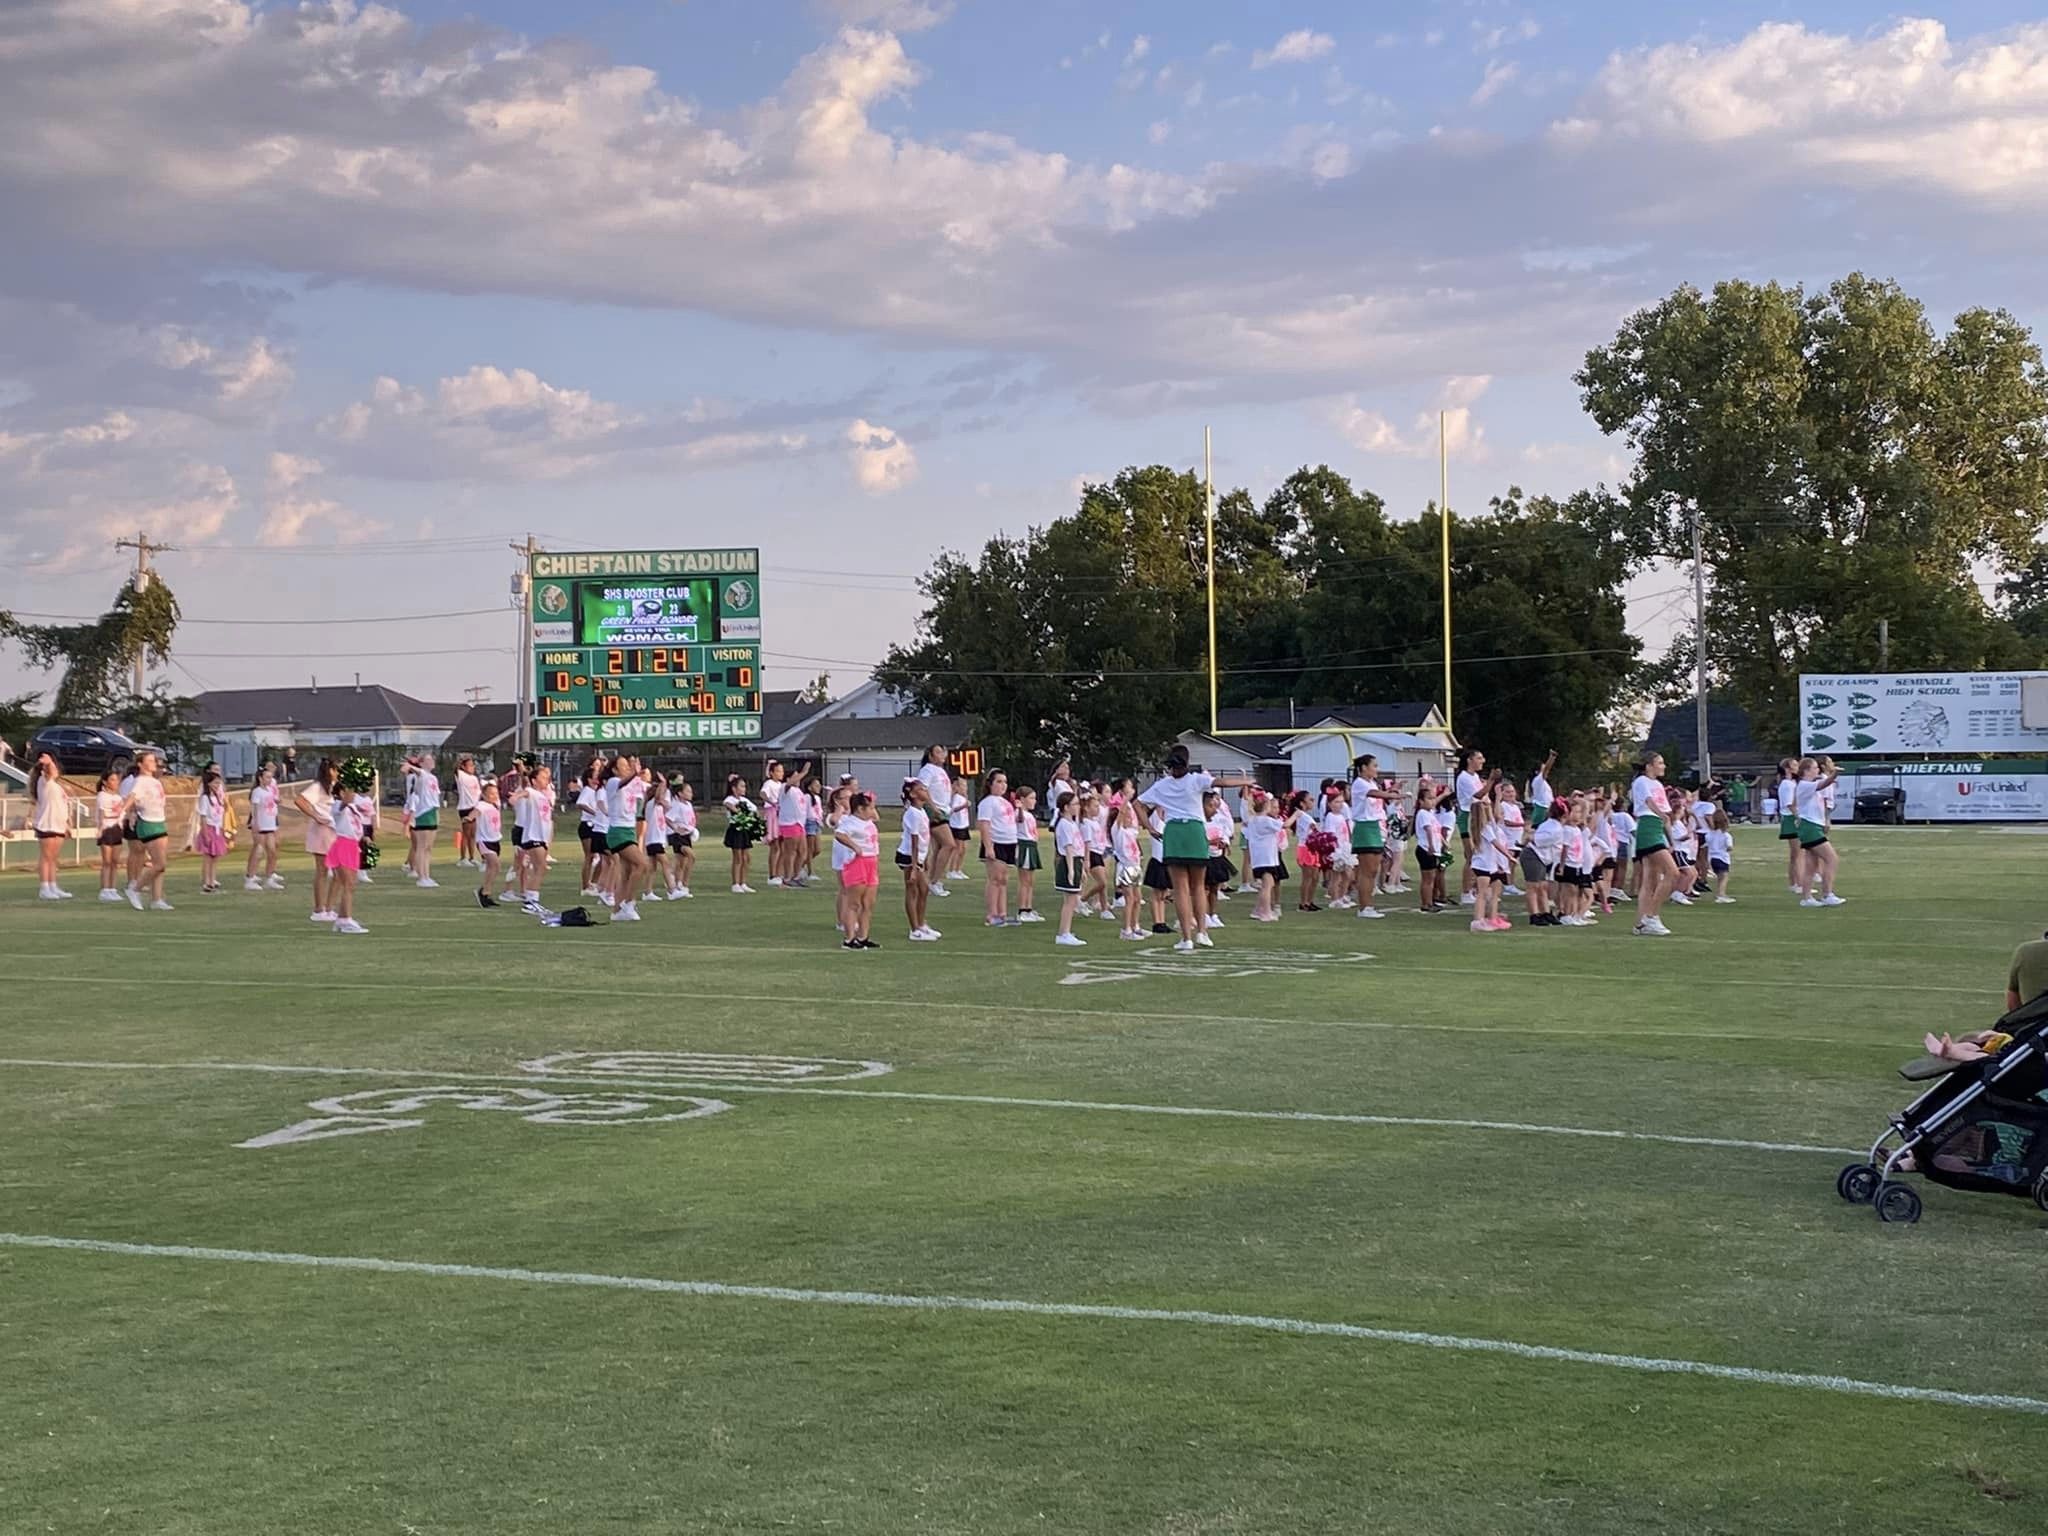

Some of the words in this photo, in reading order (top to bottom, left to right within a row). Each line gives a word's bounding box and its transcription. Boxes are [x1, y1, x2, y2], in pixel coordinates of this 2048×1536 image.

[535, 554, 650, 575] CHIEFTAIN
[657, 552, 755, 572] STADIUM
[603, 588, 622, 600] SHS
[624, 587, 665, 599] BOOSTER
[666, 586, 690, 598] CLUB
[669, 603, 679, 615] 23
[606, 633, 689, 642] WOMACK
[545, 652, 580, 665] HOME
[712, 649, 753, 660] VISITOR
[556, 671, 570, 692] 0
[675, 678, 689, 688] TOL
[739, 667, 752, 687] 0
[1836, 678, 1879, 686] CHAMPS
[1895, 677, 1953, 686] SEMINOLE
[607, 680, 622, 689] TOL
[1885, 688, 1914, 696] HIGH
[1917, 687, 1963, 695] SCHOOL
[552, 700, 579, 712] DOWN
[602, 695, 620, 715] 10
[622, 699, 632, 710] TO
[634, 699, 647, 710] GO
[654, 698, 676, 709] BALL
[676, 697, 689, 709] ON
[690, 692, 715, 713] 40
[725, 695, 745, 708] QTR
[538, 722, 595, 740] MIKE
[601, 721, 691, 739] SNYDER
[697, 719, 760, 736] FIELD
[951, 750, 979, 775] 40
